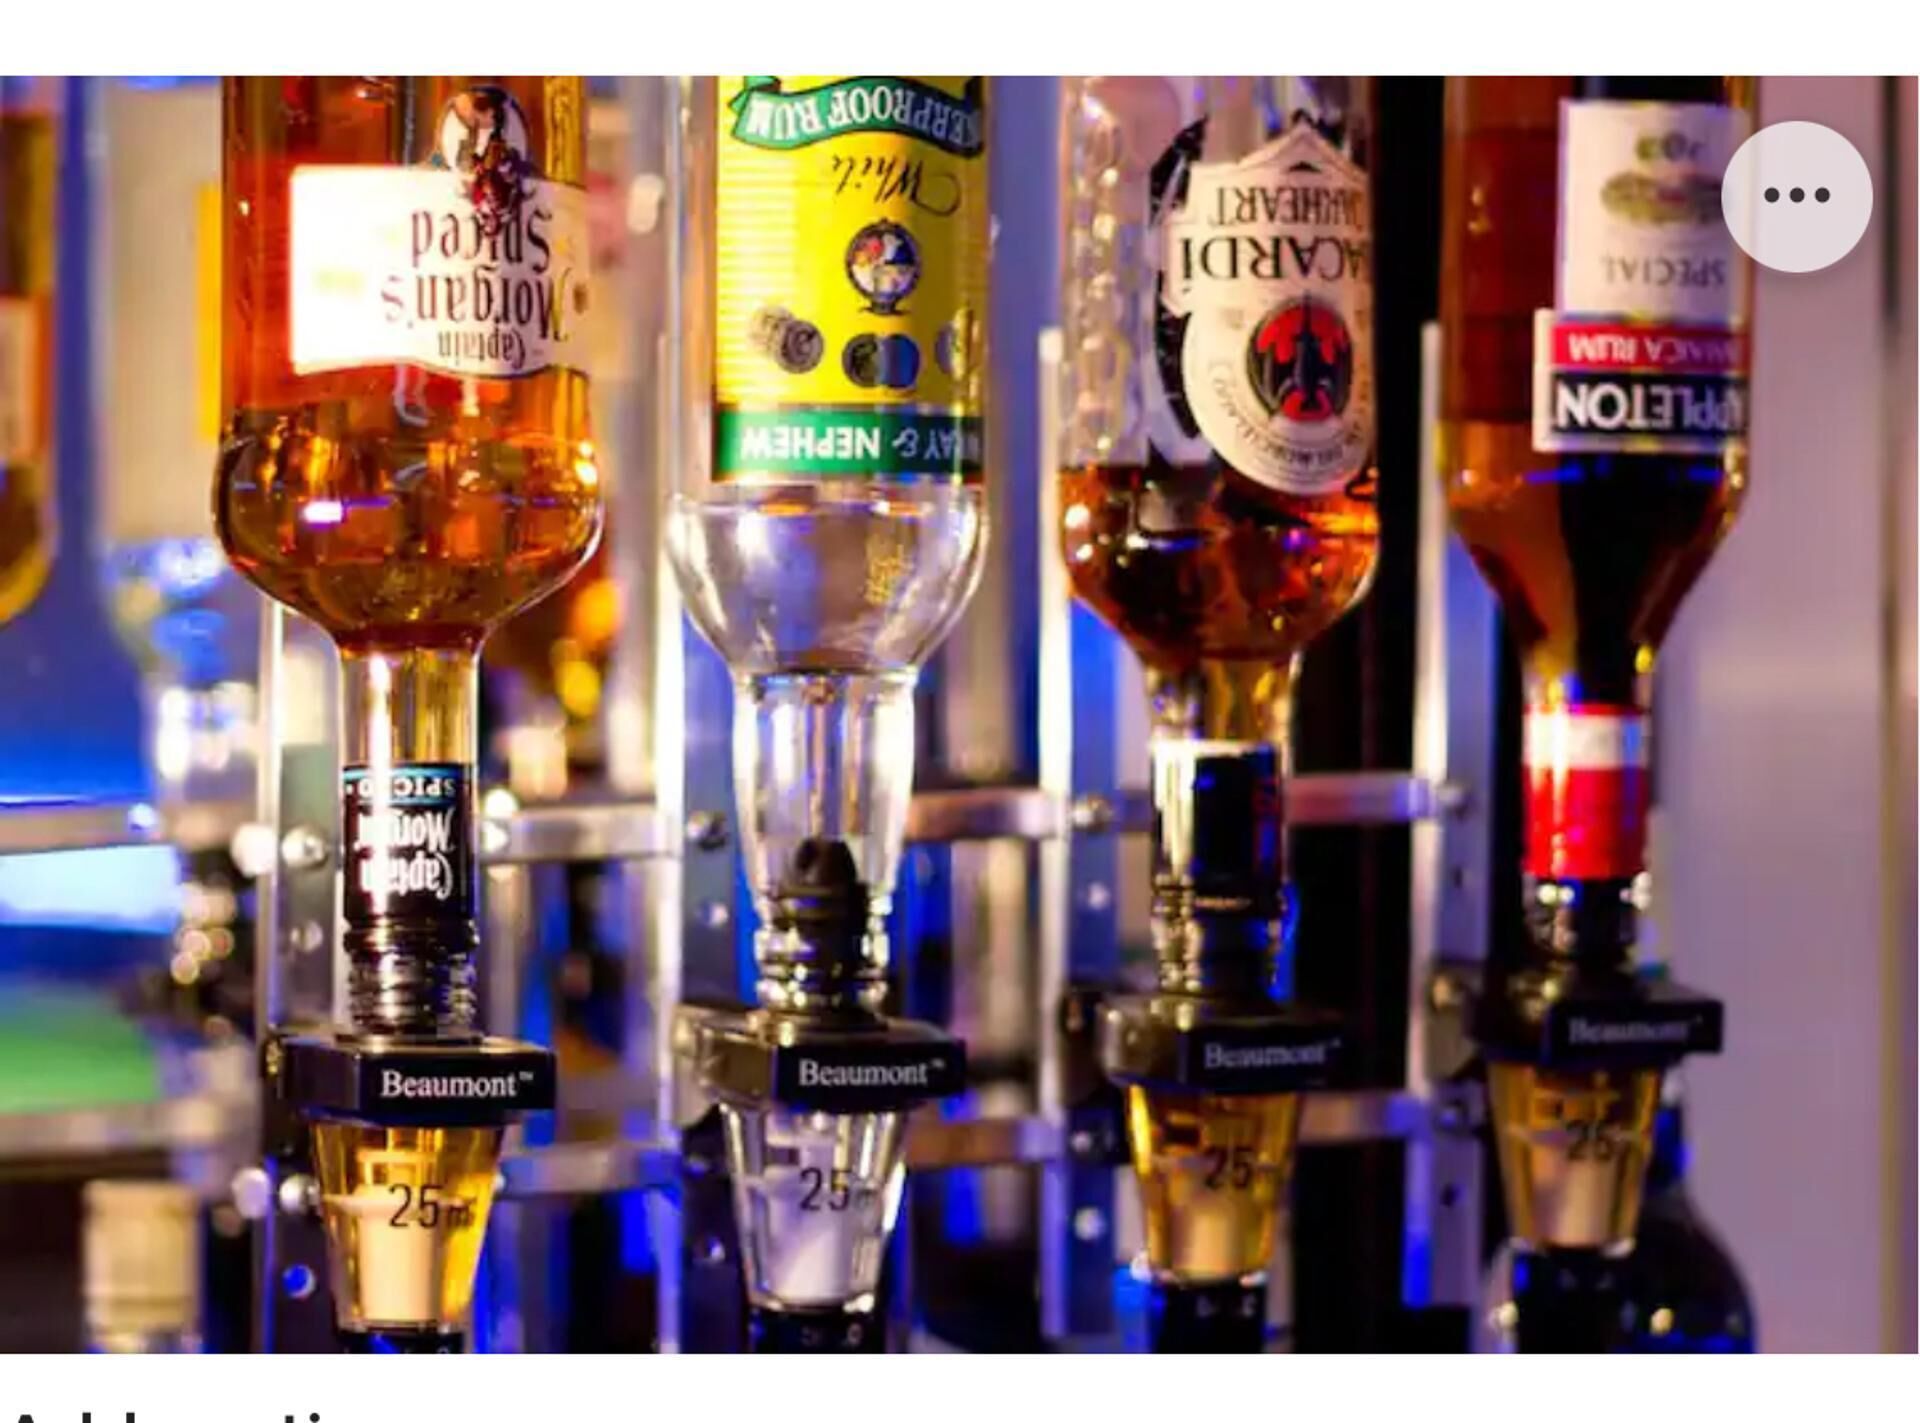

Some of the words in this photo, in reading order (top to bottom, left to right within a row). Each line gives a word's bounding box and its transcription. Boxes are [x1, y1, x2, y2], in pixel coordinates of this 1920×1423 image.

[745, 94, 825, 141] RUM
[832, 155, 963, 217] White
[410, 209, 554, 274] Spiced
[1604, 255, 1726, 289] SPECIAL
[381, 266, 572, 342] Morgan's
[437, 329, 526, 369] Captain
[1568, 333, 1639, 365] RUM
[740, 425, 881, 459] NEPHEW
[891, 427, 921, 458] &
[358, 777, 457, 798] SPICD
[360, 850, 454, 900] Captan
